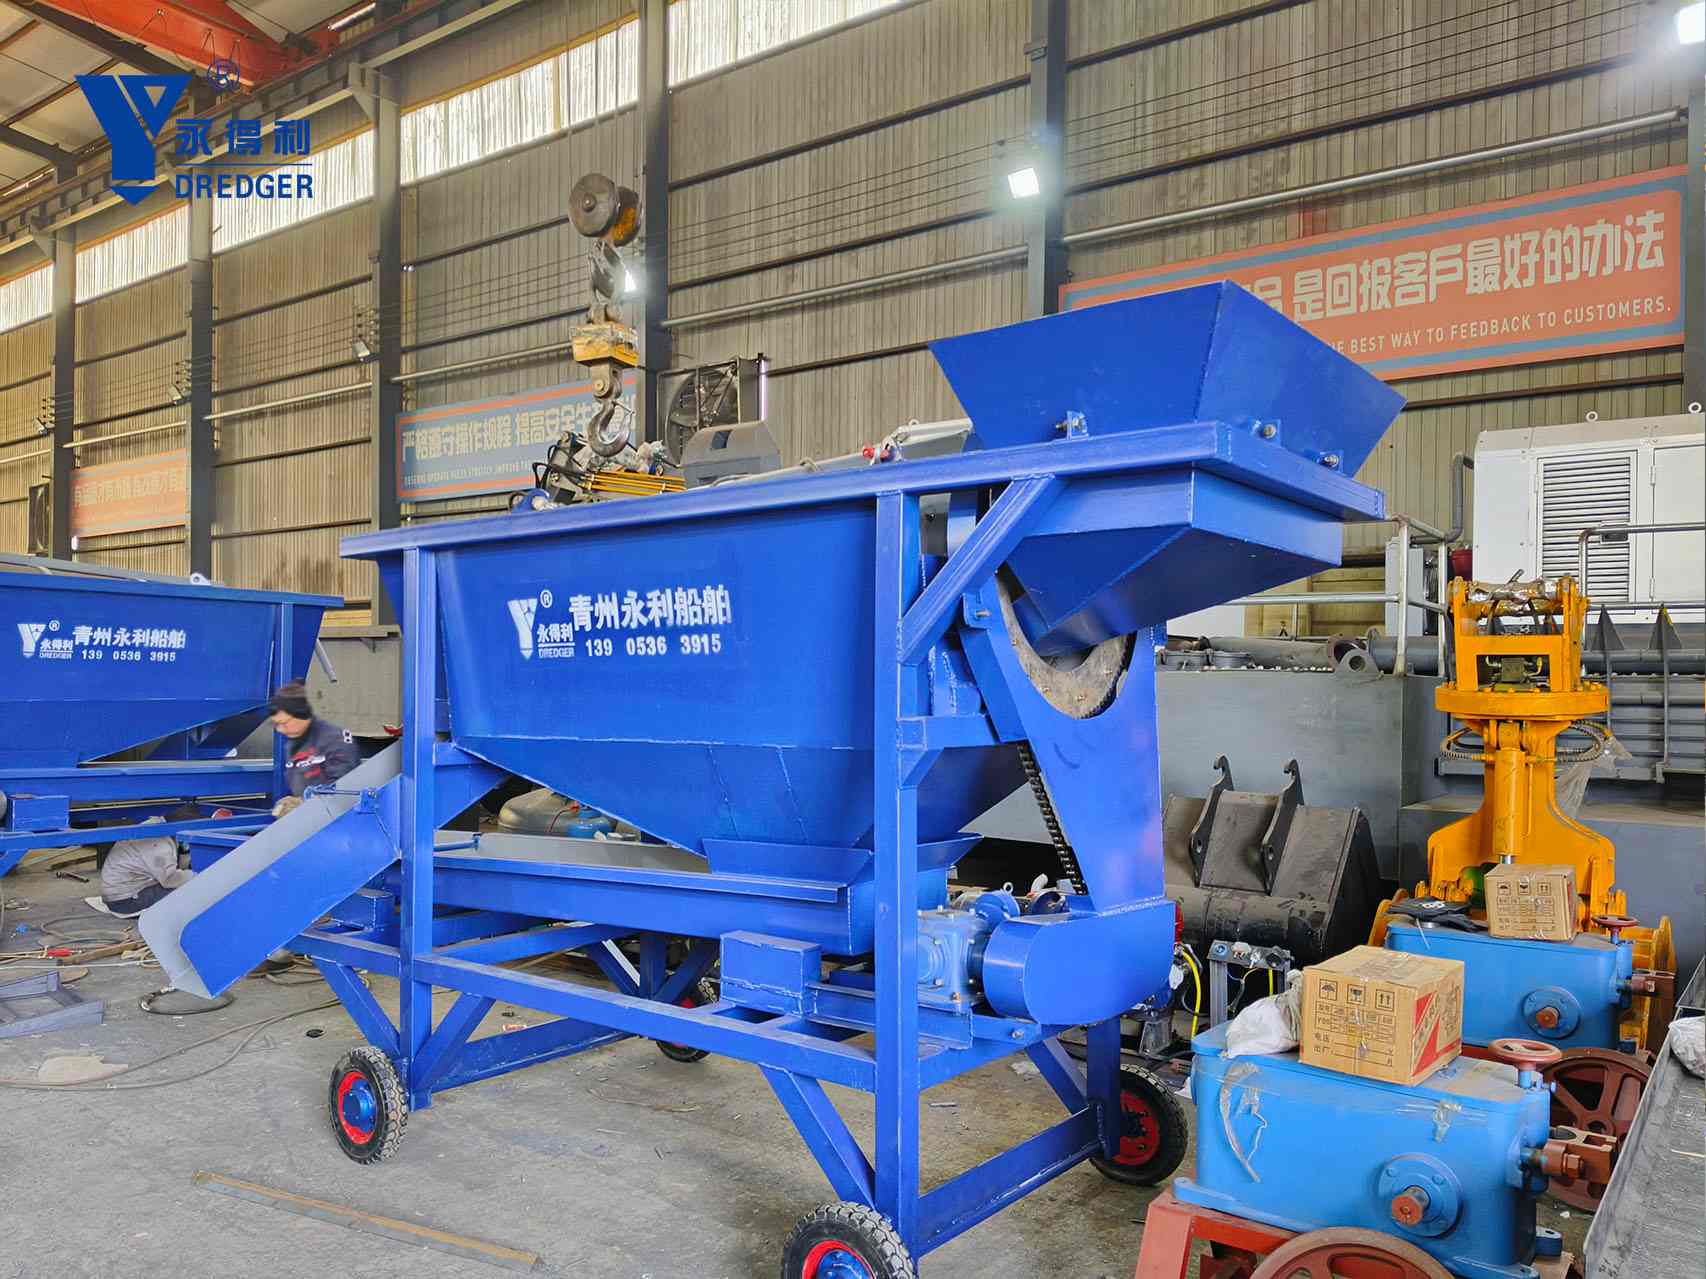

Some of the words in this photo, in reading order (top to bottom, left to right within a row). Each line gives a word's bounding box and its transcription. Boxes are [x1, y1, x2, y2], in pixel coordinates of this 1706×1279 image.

[1293, 209, 1665, 322] 是回报客户最好的办法
[1351, 335, 1385, 354] BEST
[1391, 328, 1421, 349] WAY
[1427, 326, 1444, 343] TO
[1450, 314, 1531, 341] FEEDBACK
[1538, 311, 1557, 329] TO
[1564, 295, 1672, 326] CUSTOMERS.
[568, 583, 732, 632] 青州永利船舶
[72, 625, 187, 649] 青州永利船舶
[537, 622, 574, 643] 永得利
[82, 649, 103, 660] 139
[113, 651, 141, 662] 0536
[150, 652, 176, 662] 3915
[585, 638, 613, 657] 139
[626, 635, 667, 656] 0536
[680, 633, 722, 656] 3915
